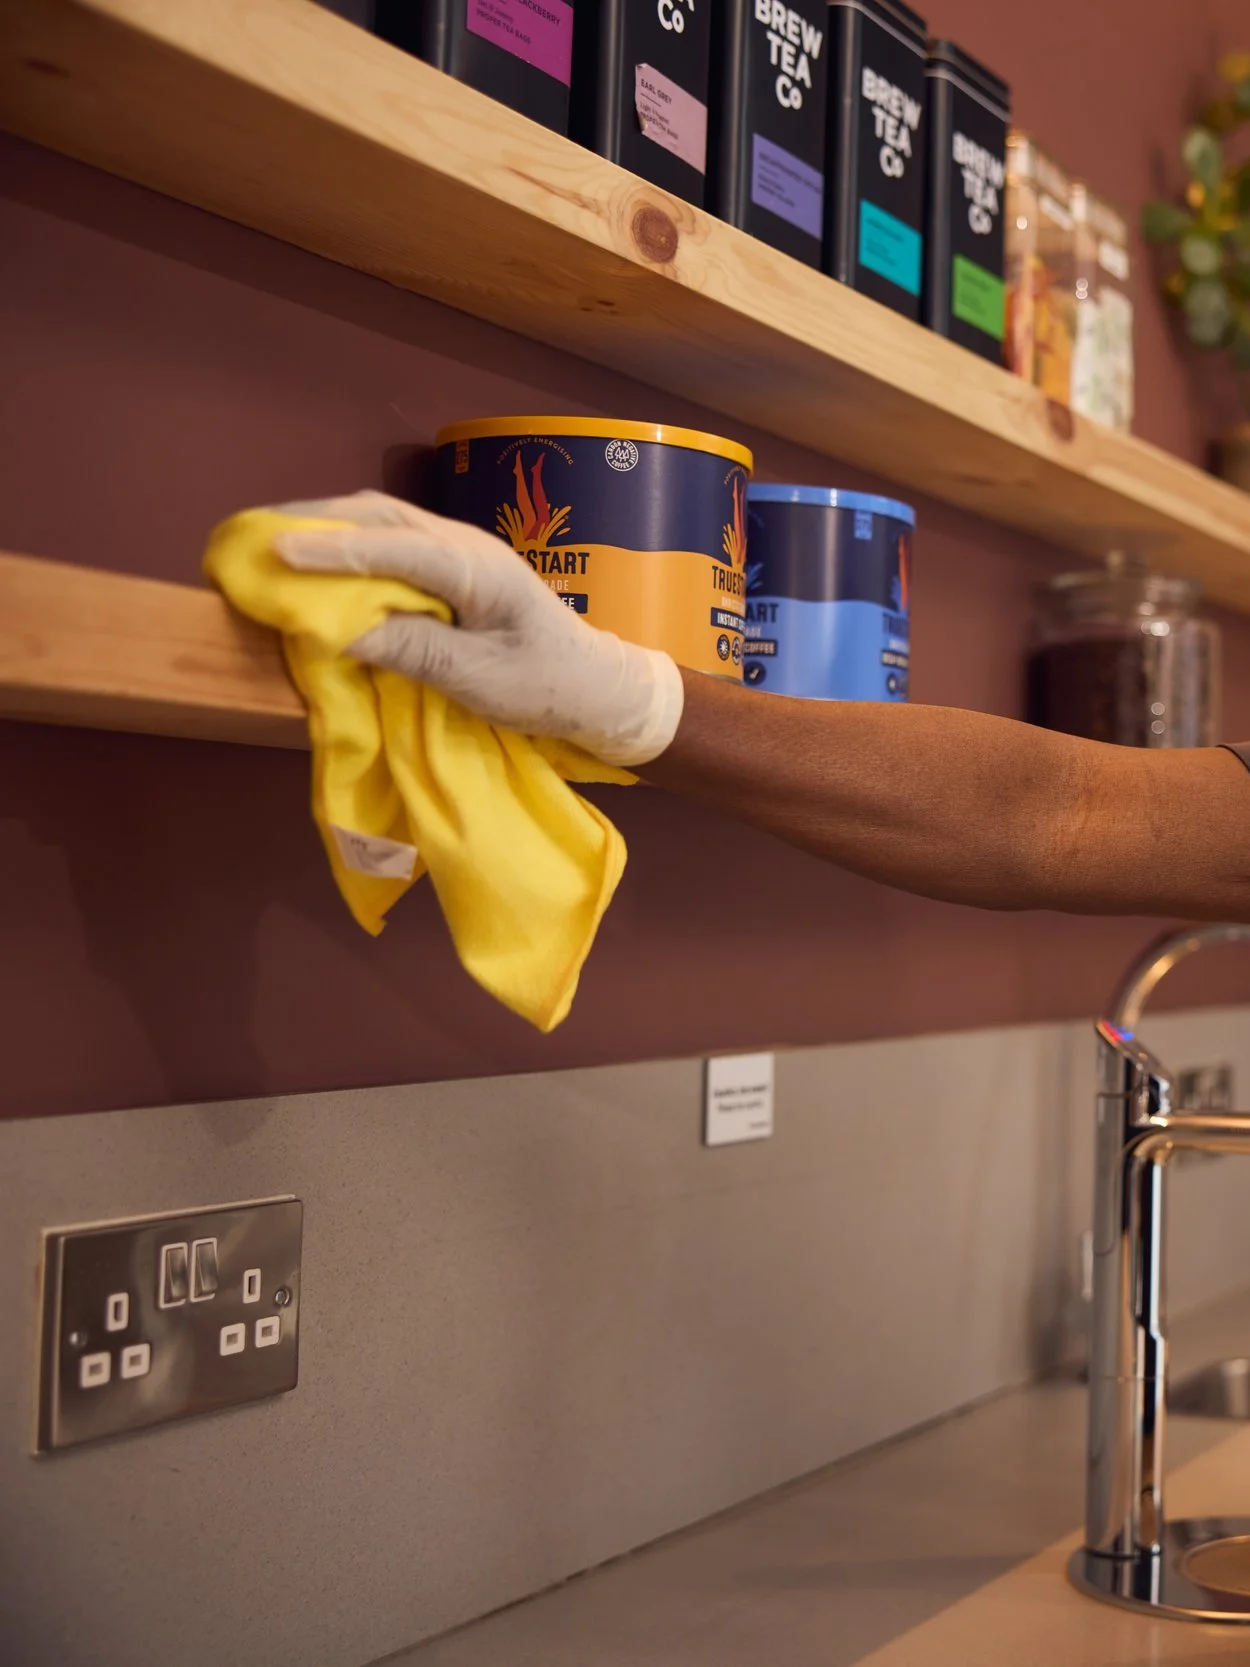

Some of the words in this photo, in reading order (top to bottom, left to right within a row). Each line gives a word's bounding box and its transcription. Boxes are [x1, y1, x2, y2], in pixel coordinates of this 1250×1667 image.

[657, 0, 684, 33] Co
[755, 0, 823, 60] BREW
[766, 30, 812, 89] TEA
[641, 78, 656, 95] EARL
[657, 90, 672, 104] GREY
[776, 74, 803, 110] Co
[862, 66, 922, 131] BREW
[872, 105, 912, 158] TEA
[879, 145, 905, 178] Co
[952, 131, 1004, 189] BREW
[961, 168, 999, 215] TEA
[968, 202, 993, 235] Co
[534, 437, 574, 465] ENERGISING
[516, 549, 590, 575] START
